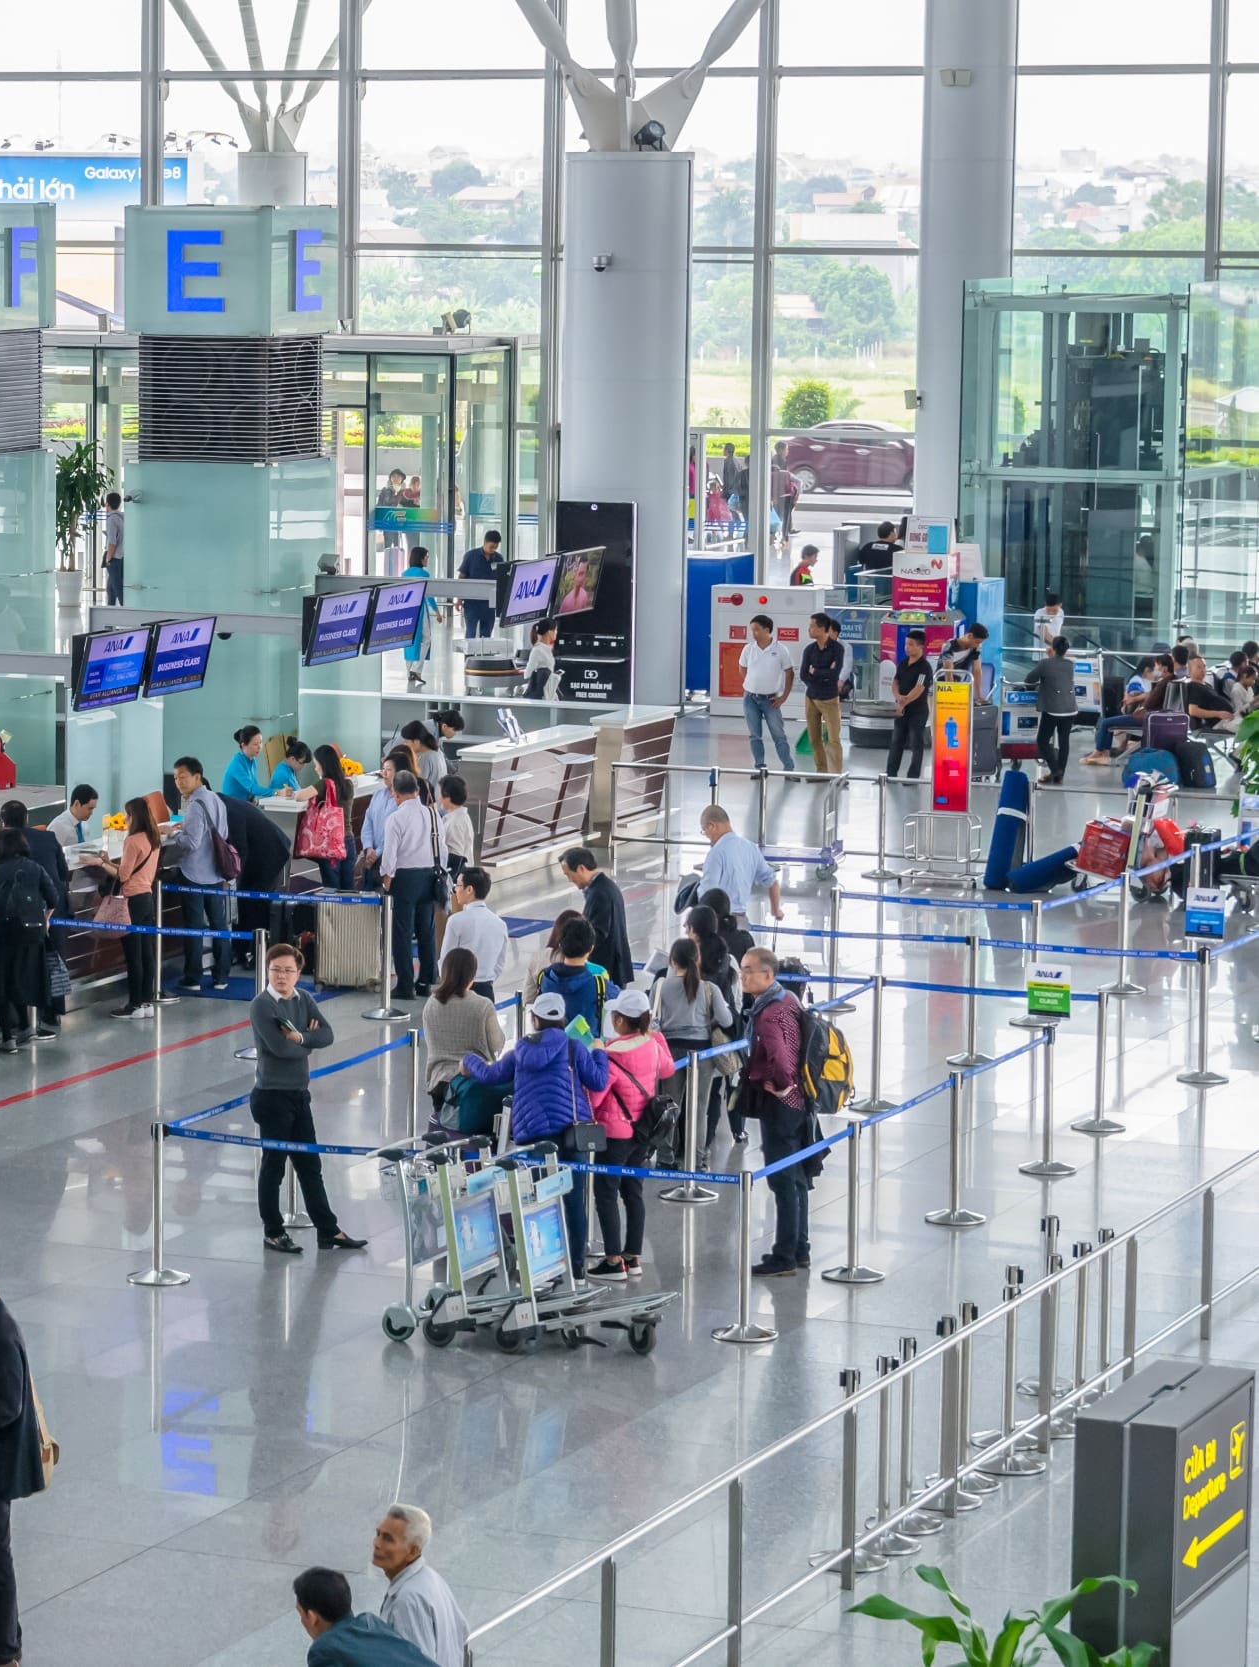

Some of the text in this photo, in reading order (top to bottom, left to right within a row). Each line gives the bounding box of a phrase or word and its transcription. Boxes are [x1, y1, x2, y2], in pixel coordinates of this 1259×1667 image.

[84, 166, 135, 183] Galaxy
[39, 177, 75, 200] lớn
[9, 227, 38, 308] F
[167, 229, 225, 313] E
[293, 229, 322, 312] E
[901, 568, 930, 576] NASCO
[514, 578, 537, 601] ANA
[387, 594, 405, 606] ANA
[331, 604, 349, 616] ANA
[375, 618, 413, 631] BUSINESS CLASS
[170, 631, 191, 645] ANA
[319, 628, 358, 642] BUSINESS CLASS
[104, 640, 124, 653] ANA
[157, 657, 201, 672] BUSINESS CLASS
[1194, 894, 1212, 902] ANA
[1035, 970, 1054, 978] ANA
[670, 1171, 713, 1181] INTERNATIONAL
[715, 1174, 739, 1183] AIRPORT
[1183, 1472, 1227, 1520] Departure
